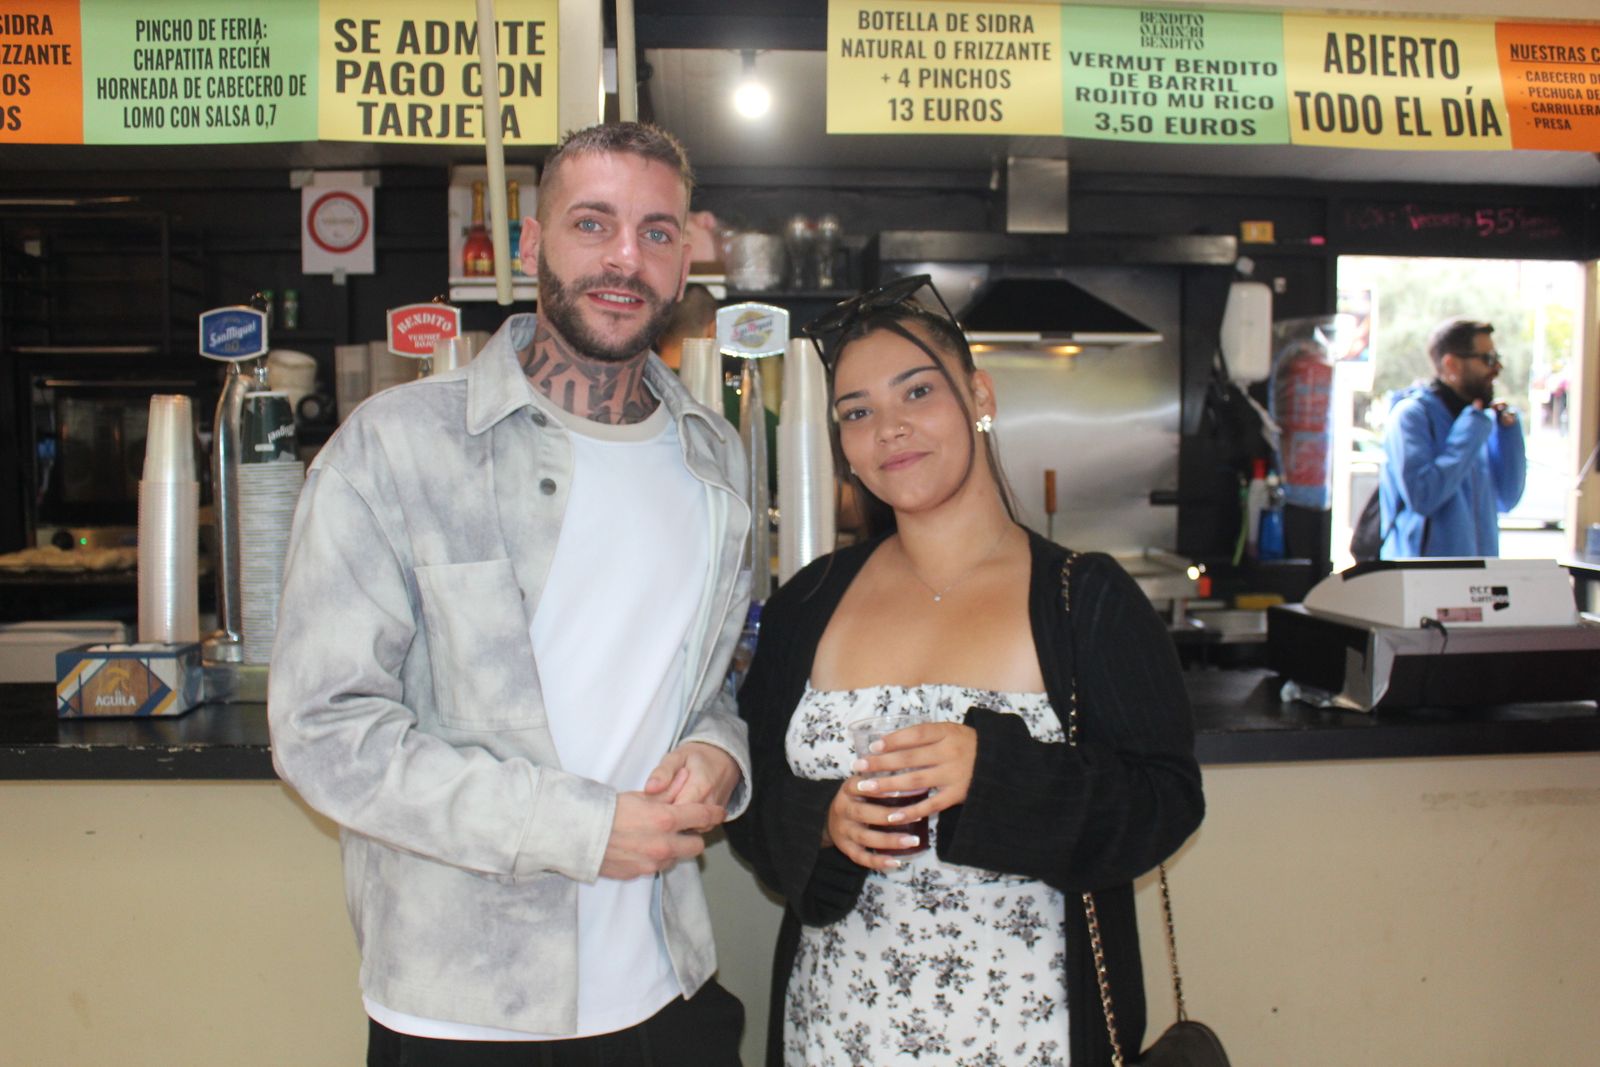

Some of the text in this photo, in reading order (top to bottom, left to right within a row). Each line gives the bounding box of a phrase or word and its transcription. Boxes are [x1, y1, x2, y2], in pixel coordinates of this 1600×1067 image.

[0, 15, 53, 36] IDRA
[136, 18, 268, 41] PINCHO DE FERIA:
[858, 10, 1034, 33] BOTELLA DE SIDRA
[1141, 12, 1204, 25] BENDITO
[334, 19, 380, 54] SE
[1141, 36, 1204, 49] BENDITO
[134, 40, 270, 70] CHAPATITA RECIÉN
[841, 39, 1051, 61] NATURAL O FRIZZANTE
[1324, 32, 1460, 79] ABIERTO
[1510, 43, 1586, 62] NUESTRAS
[1069, 51, 1278, 76] VERMUT BENDITO
[97, 75, 306, 100] HORNEADA DE CABECERO DE
[336, 60, 444, 95] PAGO
[899, 68, 910, 87] 4
[919, 68, 1011, 89] PINCHOS
[1110, 72, 1239, 93] DE BARRIL
[1526, 70, 1600, 84] CABECERO D
[1076, 87, 1273, 110] ROJITO MU RICO
[1528, 87, 1583, 99] PECHUGA
[124, 104, 277, 129] LOMO CON SALSA 0,7
[888, 98, 1003, 121] 13 EUROS
[1294, 86, 1502, 137] TODO EL DÍA
[1095, 113, 1256, 136] 3,50 EUROS
[1534, 117, 1571, 130] PRESA
[397, 312, 452, 333] BENDITO
